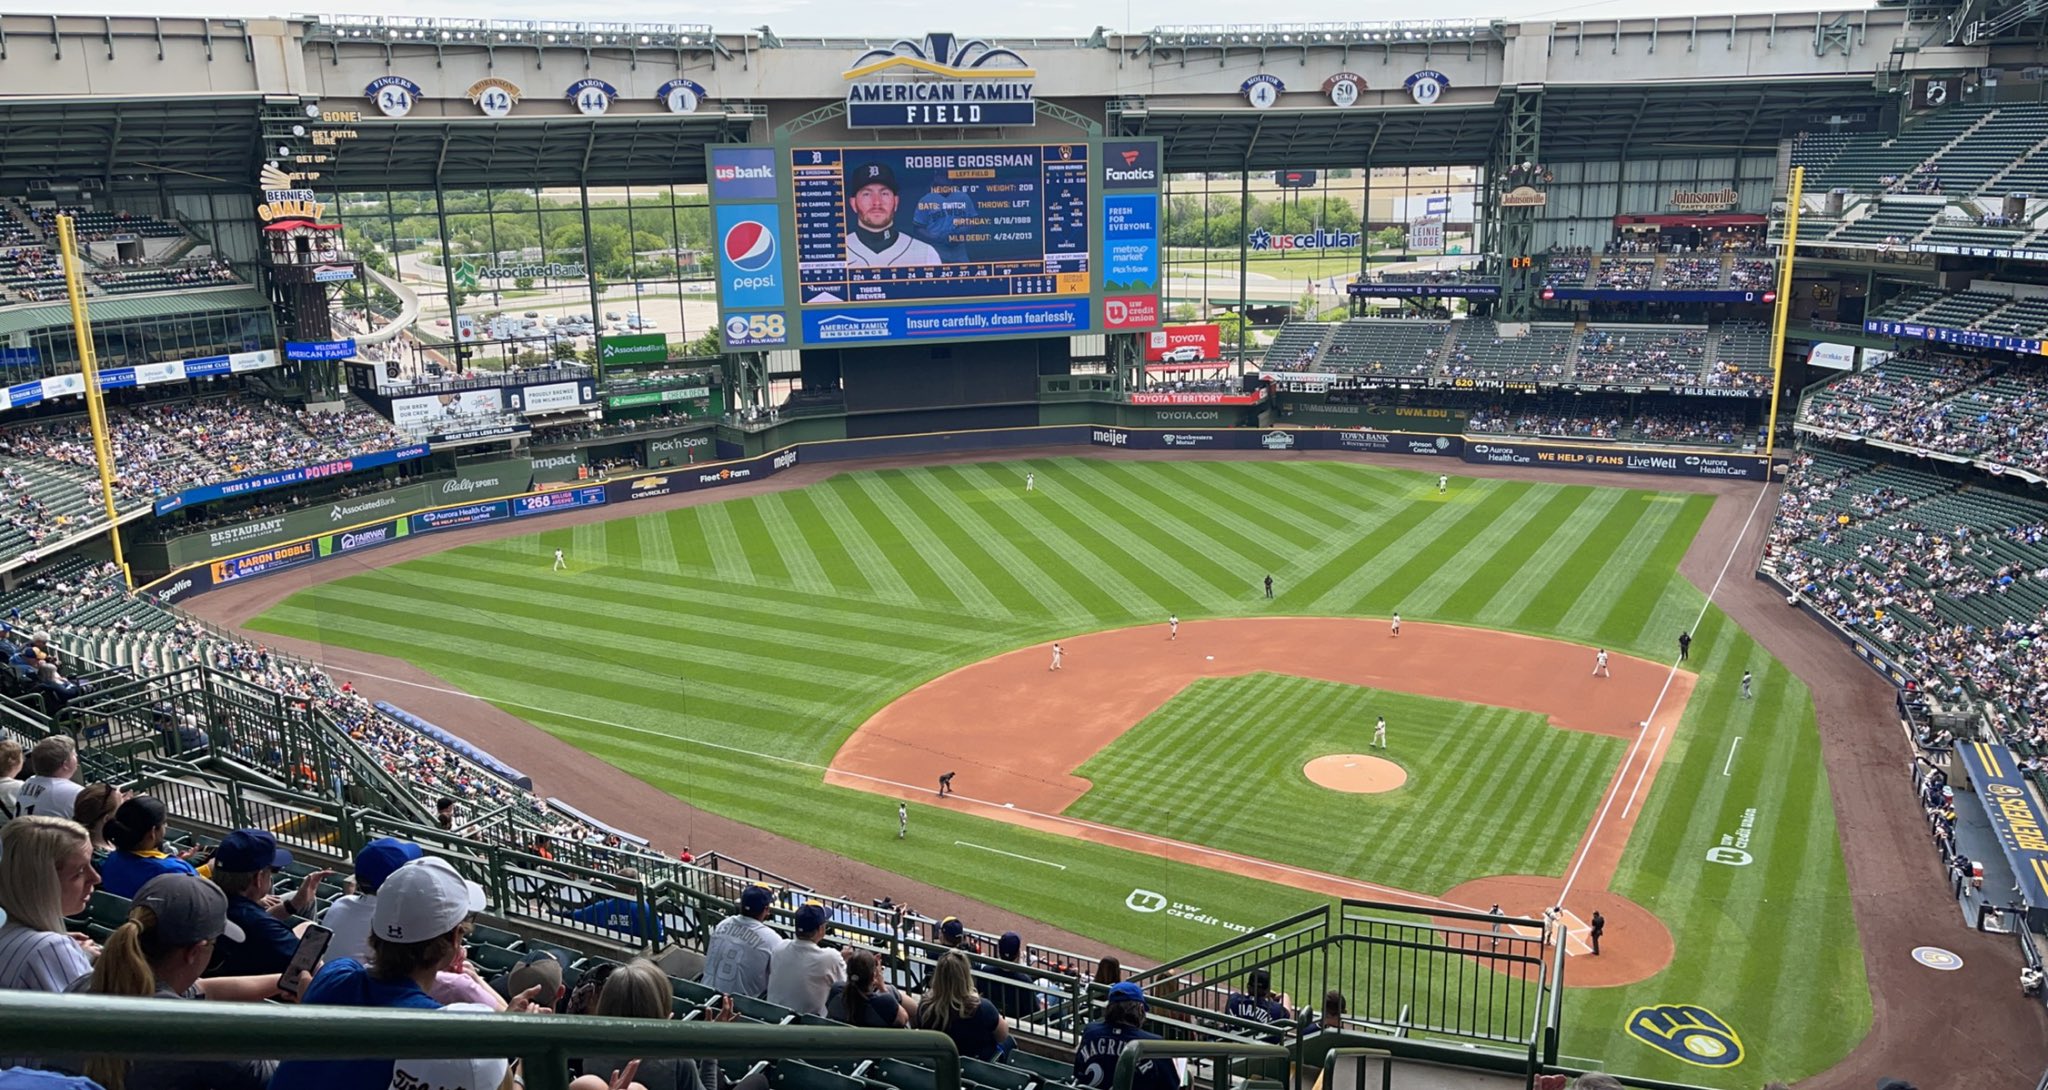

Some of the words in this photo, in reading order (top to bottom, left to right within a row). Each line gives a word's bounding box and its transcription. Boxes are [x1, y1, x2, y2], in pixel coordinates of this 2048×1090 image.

[1330, 73, 1358, 82] UECKER
[1415, 70, 1440, 79] YOUNT
[373, 77, 411, 89] FINGERS
[474, 79, 513, 91] ROBINSON
[578, 79, 604, 89] AARON
[669, 80, 692, 88] SELIG
[1247, 75, 1278, 86] MOLITOR
[850, 84, 955, 101] AMERICAN
[963, 83, 1033, 101] FAMILY
[1256, 87, 1266, 101] 4
[1337, 83, 1353, 95] 50
[1416, 83, 1436, 99] 19
[383, 92, 407, 110] 34
[485, 93, 507, 110] 42
[582, 93, 604, 111] 44
[679, 94, 688, 111] 1
[323, 111, 361, 122] GONE!
[907, 105, 981, 123] FIELD
[312, 130, 328, 139] GET
[331, 130, 358, 139] OUTTA
[313, 137, 336, 145] HERE
[296, 155, 313, 164] GET
[314, 155, 327, 164] UP
[905, 156, 955, 168] ROBBIE
[958, 154, 1033, 168] GROSSMAN
[289, 172, 306, 181] GET
[308, 172, 320, 180] UP
[1106, 168, 1154, 181] Fanatics
[931, 186, 960, 194] HEIGHT:
[986, 184, 1016, 192] WEIGHT:
[266, 190, 314, 202] BERNIE'S
[1502, 193, 1545, 204] Johnsonville
[1670, 188, 1738, 204] Johnsonville
[942, 202, 966, 210] SWITCH
[977, 201, 1009, 209] THROWS:
[1012, 200, 1030, 208] LEFT
[258, 202, 325, 221] CHALET
[1109, 207, 1132, 215] FRESH
[953, 217, 991, 225] BIRTHDAY:
[1109, 215, 1124, 223] FOR
[1109, 222, 1152, 231] EVERYONE.
[1412, 226, 1439, 237] LEINIE
[949, 234, 965, 242] MLB
[965, 233, 992, 241] DEBUT:
[994, 232, 1032, 241] 4/24/2013
[1412, 236, 1439, 247] LODGE
[1113, 253, 1143, 262] market
[733, 274, 774, 290] pepsi
[1070, 284, 1077, 292] K
[856, 292, 886, 300] BREWERS
[1129, 306, 1154, 314] credit
[906, 318, 940, 329] Insure
[942, 315, 989, 328] carefully,
[991, 312, 1022, 325] dream
[1025, 310, 1075, 323] fearlessly.
[1129, 314, 1154, 322] union
[750, 314, 786, 338] 58
[821, 323, 859, 331] AMERICAN
[861, 322, 888, 330] FAMILY
[1169, 334, 1206, 343] TOYOTA
[288, 350, 322, 358] AMERICAN
[325, 348, 353, 358] FAMILY
[186, 364, 213, 372] STADIUM
[214, 361, 230, 369] CLUB
[118, 373, 135, 381] CLUB
[1455, 379, 1473, 387] 620
[1475, 379, 1504, 388] WTMJ
[666, 390, 688, 400] CHECK
[690, 389, 706, 398] DECK
[1684, 388, 1703, 396] MLB
[1705, 389, 1749, 397] NETWORK
[1133, 395, 1169, 403] TOYOTA
[1172, 394, 1222, 403] TERRITORY
[1156, 411, 1219, 420] TOYOTA.COM
[1396, 408, 1447, 418] UWM.EDU
[683, 436, 709, 448] Save
[1093, 429, 1127, 446] meijer
[1340, 432, 1365, 441] TOWN
[1366, 433, 1389, 442] BANK
[1408, 440, 1432, 448] Johnson
[1413, 446, 1437, 454] Controls
[1489, 446, 1513, 454] Aurora
[531, 453, 577, 470] impact
[774, 450, 797, 469] meijer
[1489, 454, 1512, 462] Health
[1513, 455, 1530, 463] Care
[1557, 453, 1584, 462] HELP
[1596, 456, 1624, 465] FANS
[700, 473, 721, 483] Fleet
[730, 468, 750, 479] Farm
[1700, 466, 1726, 475] Health
[1728, 467, 1747, 475] Care
[222, 484, 250, 494] THERE'S
[251, 480, 261, 489] NO
[263, 477, 279, 487] BALL
[281, 474, 296, 483] LIKE
[305, 462, 345, 480] POWER
[443, 478, 475, 494] Bally
[475, 478, 499, 488] SPORTS
[632, 487, 670, 499] CHEVROLET
[522, 495, 551, 509] $268
[436, 509, 459, 519] Aurora
[459, 506, 480, 516] Health
[481, 504, 495, 513] Care
[355, 527, 387, 542] FAIRWAY
[238, 553, 272, 569] AARON
[274, 543, 312, 560] BOBBLE
[158, 578, 193, 602] SignalWire
[1172, 902, 1201, 913] uw
[1167, 909, 1219, 926] credit
[1223, 922, 1276, 940] unin
